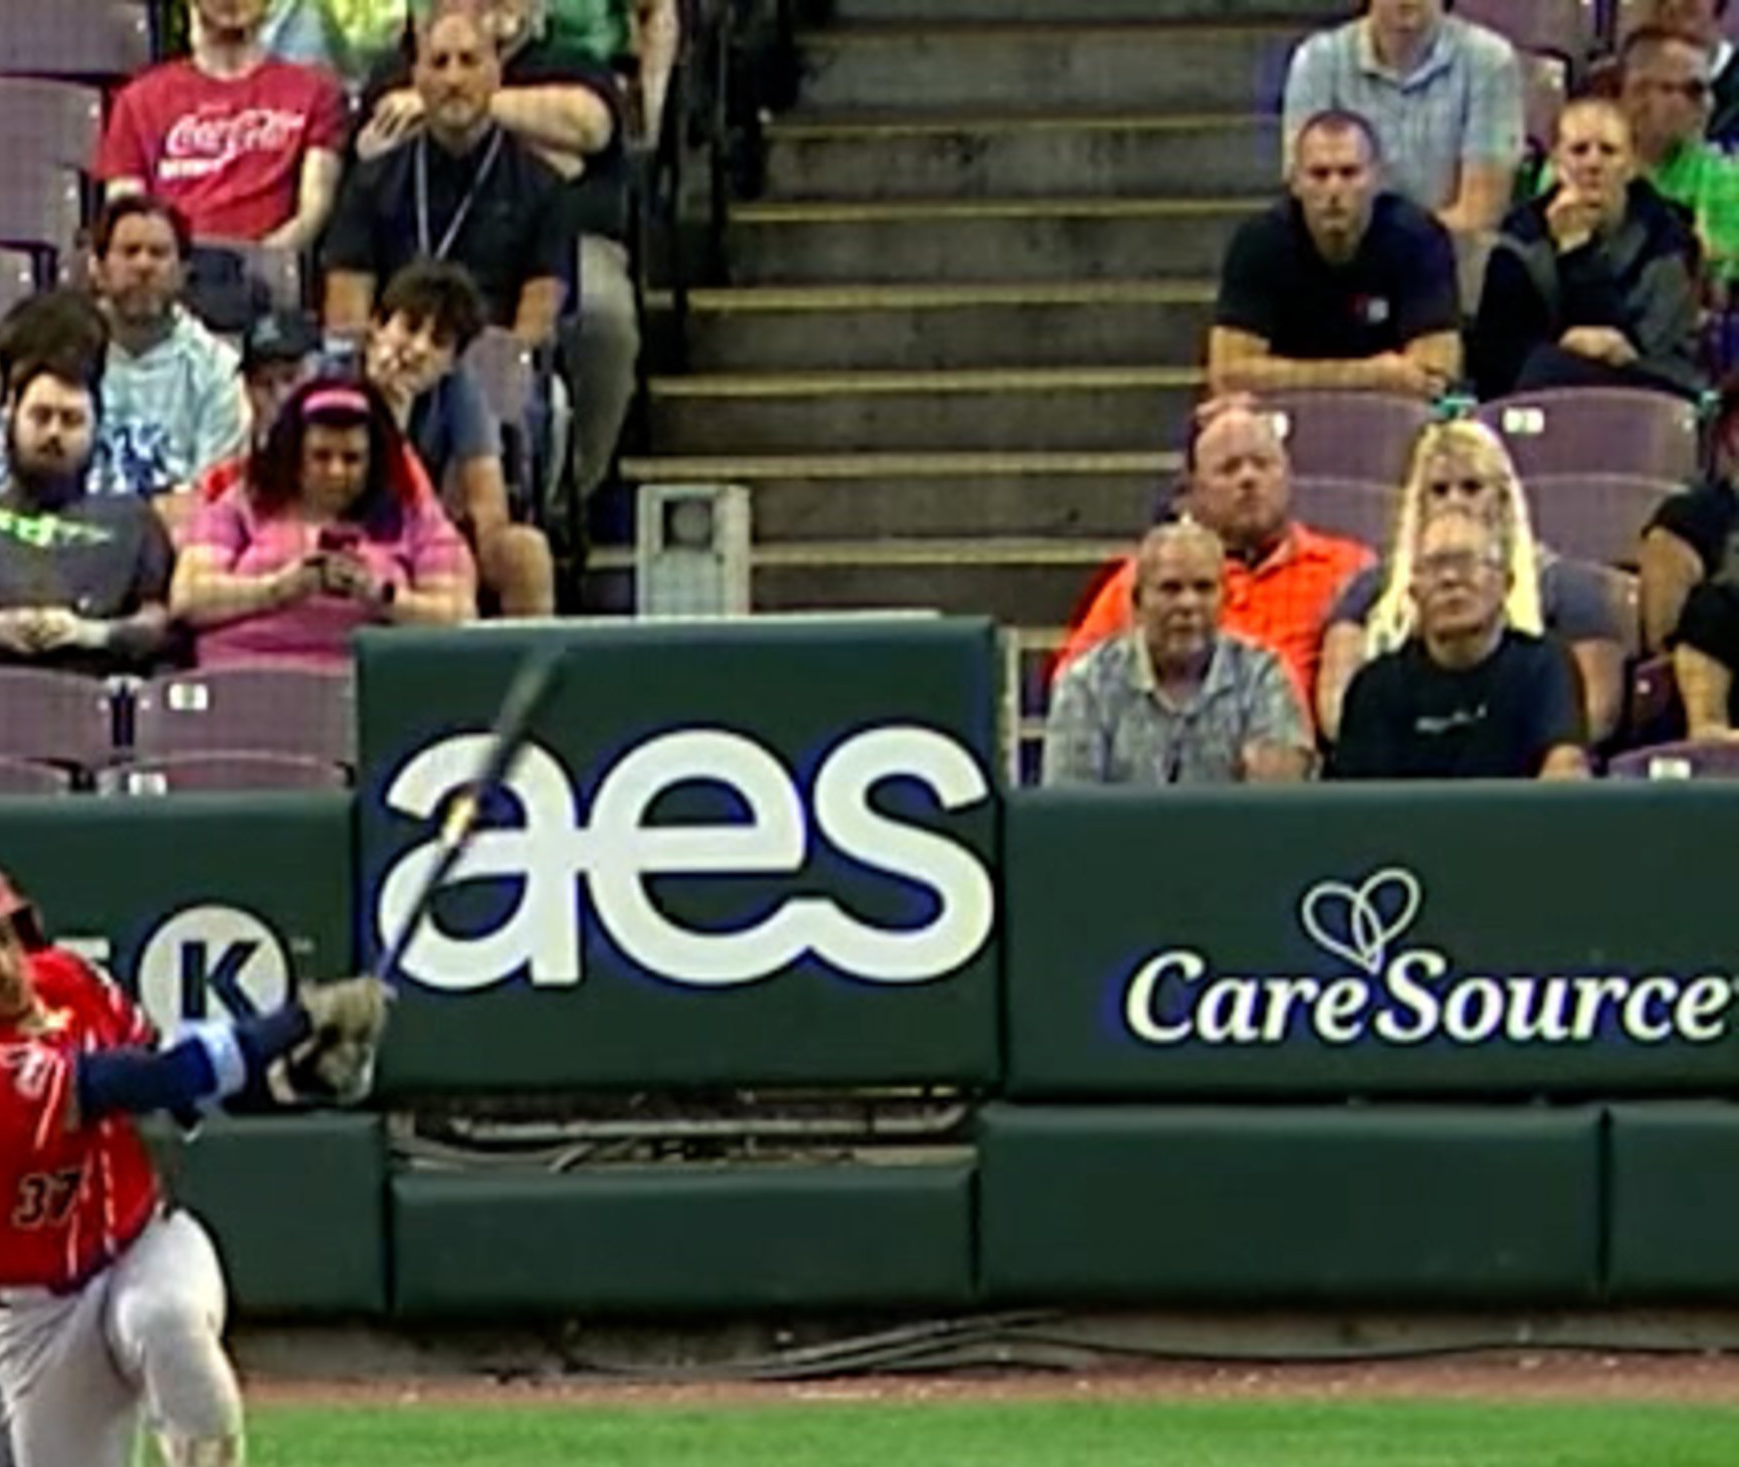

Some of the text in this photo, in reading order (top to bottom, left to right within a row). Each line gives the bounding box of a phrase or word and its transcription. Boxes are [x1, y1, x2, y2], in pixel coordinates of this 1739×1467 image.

[379, 728, 993, 987] aes
[1126, 950, 1735, 1042] CareSource
[11, 1168, 81, 1229] 37
